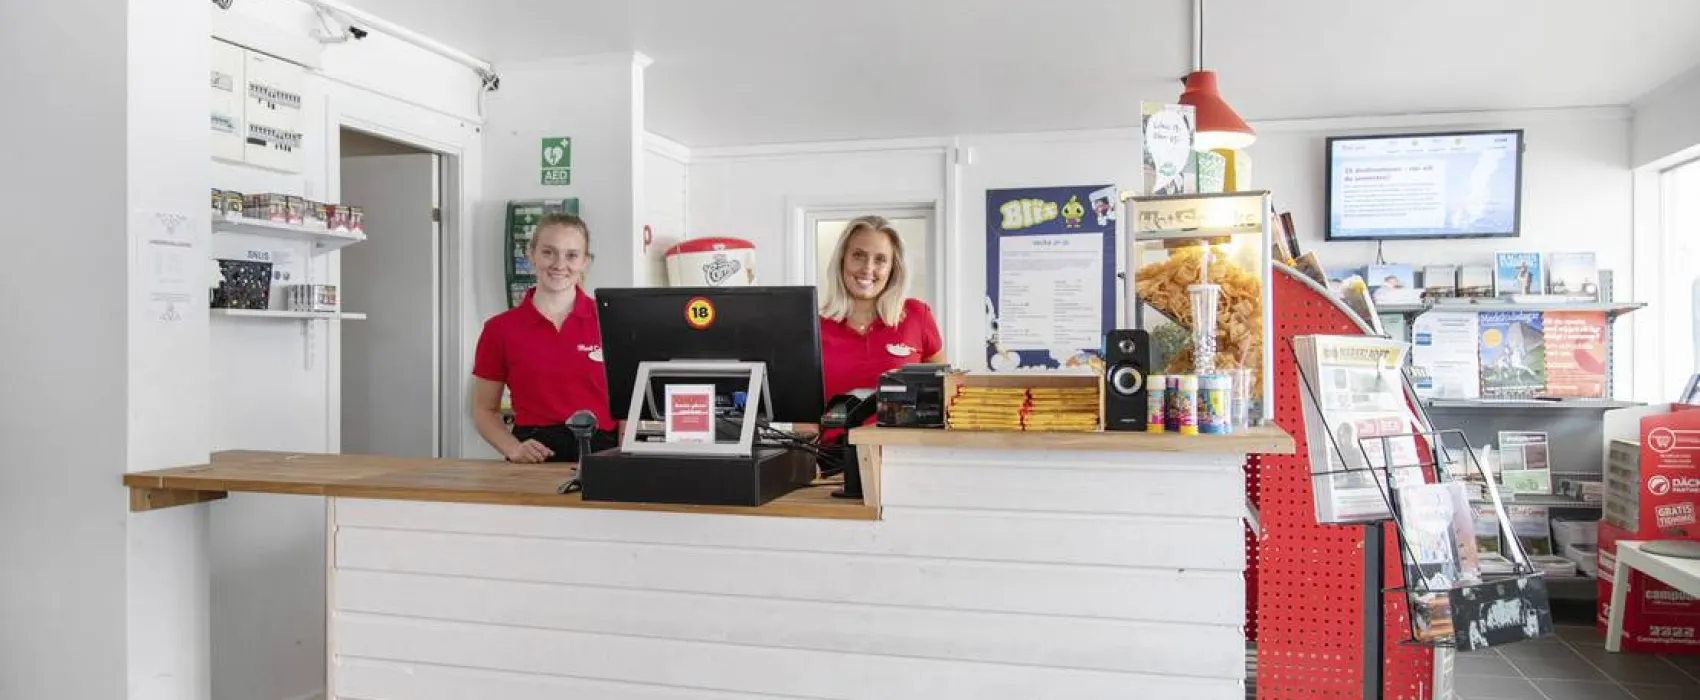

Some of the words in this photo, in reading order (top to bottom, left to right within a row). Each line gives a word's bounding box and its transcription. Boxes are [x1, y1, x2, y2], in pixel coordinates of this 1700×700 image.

[545, 170, 568, 180] AED
[691, 307, 709, 319] 18
[1658, 505, 1693, 517] GRATIS
